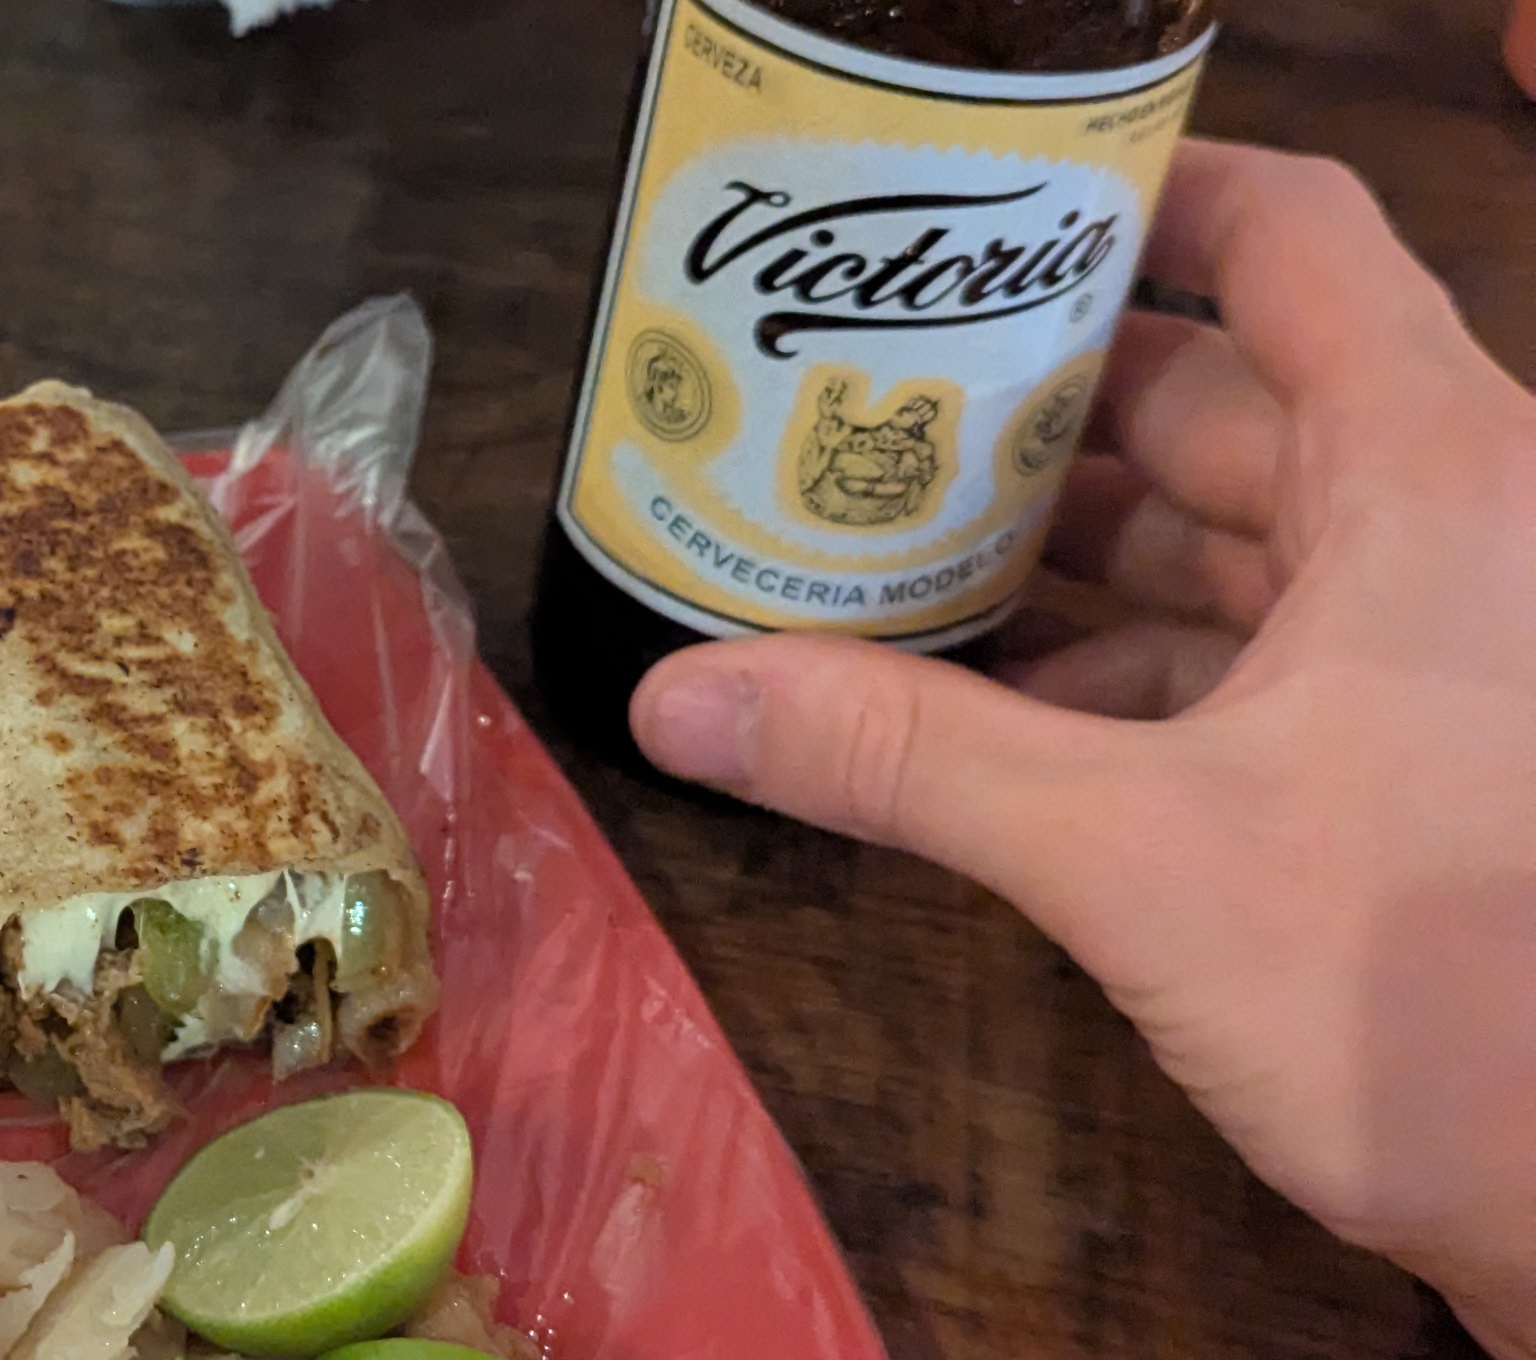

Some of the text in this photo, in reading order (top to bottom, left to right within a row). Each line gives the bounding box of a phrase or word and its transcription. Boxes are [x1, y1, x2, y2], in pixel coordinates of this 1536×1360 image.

[684, 23, 762, 96] CERVEZA
[683, 180, 1118, 360] Victoria
[649, 494, 1016, 608] CERVECERIA MODELO
